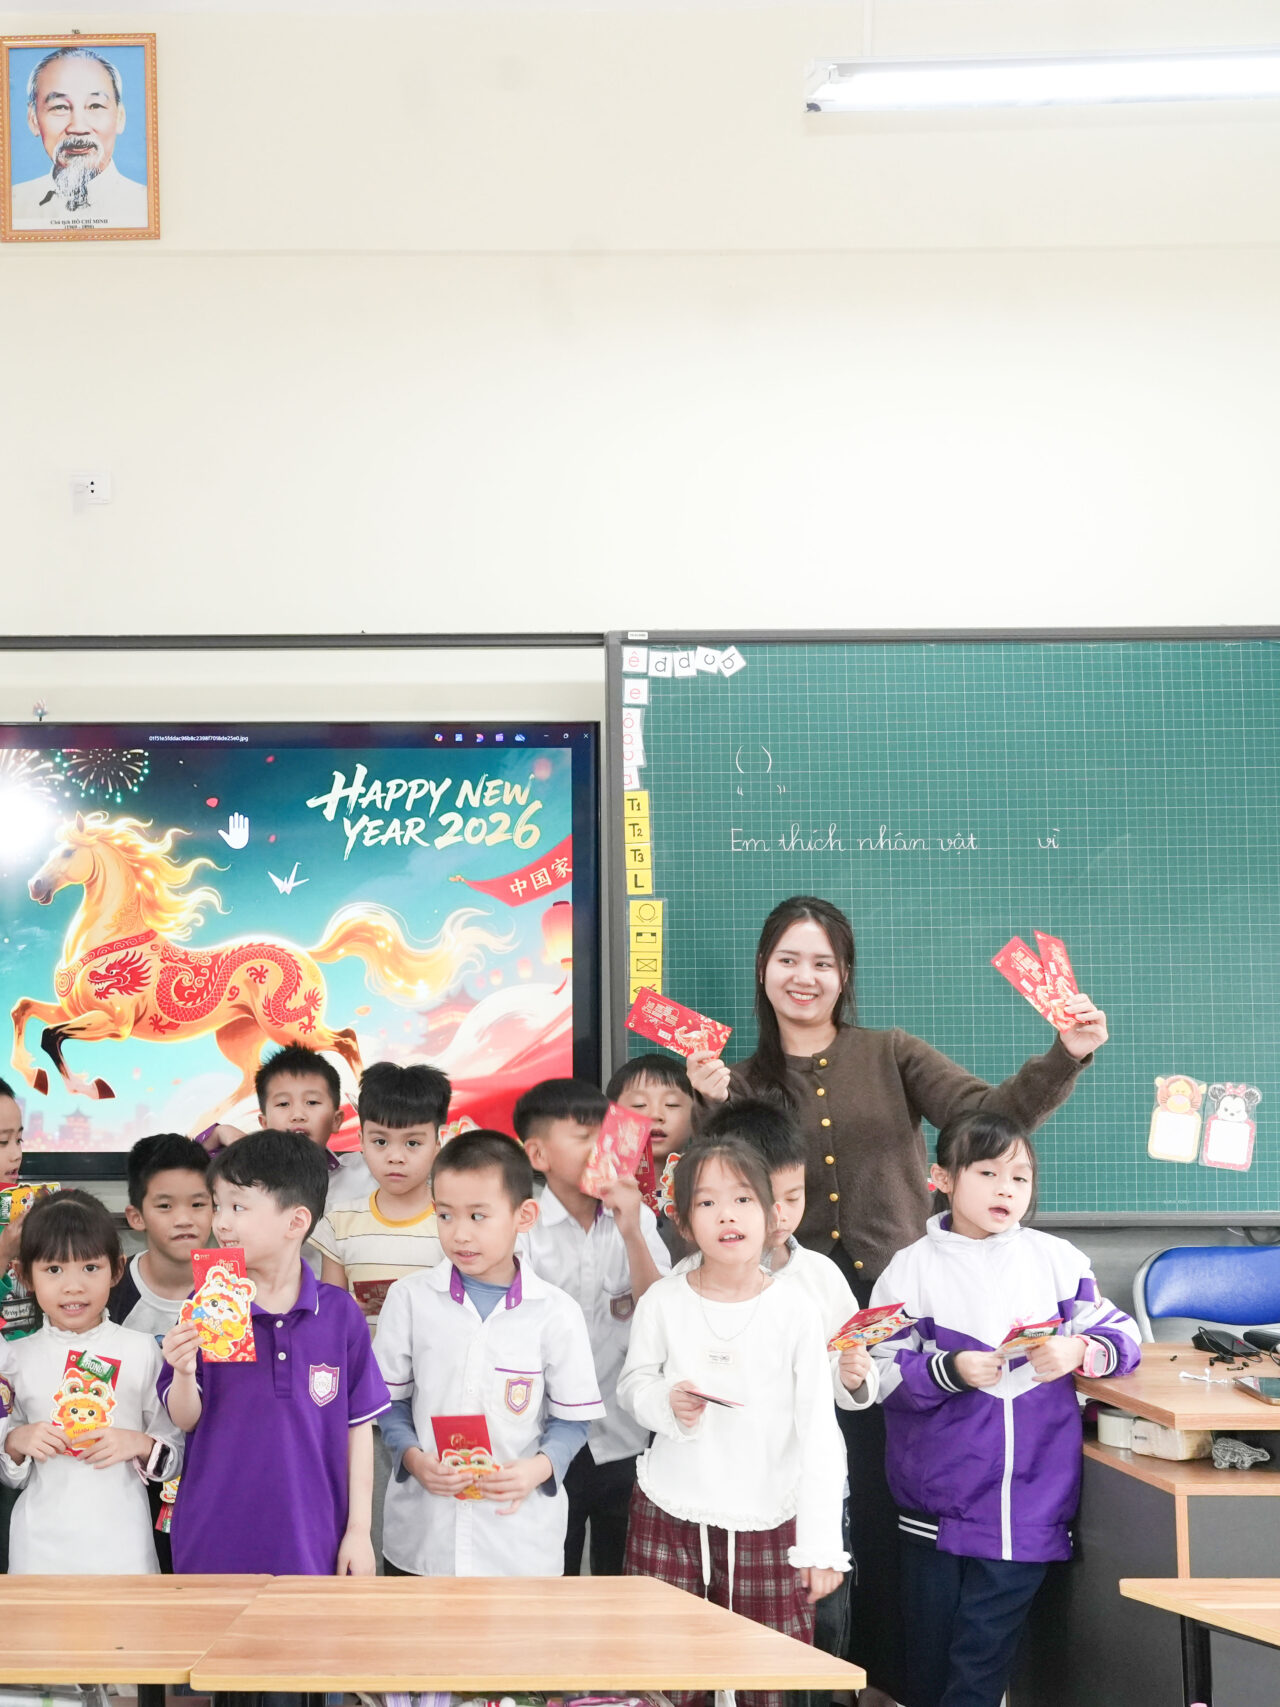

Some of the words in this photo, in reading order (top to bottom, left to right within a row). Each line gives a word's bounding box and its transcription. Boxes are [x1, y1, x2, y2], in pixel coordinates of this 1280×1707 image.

[630, 688, 641, 699] e
[306, 763, 452, 821] HAPPY
[455, 773, 535, 809] NEW
[627, 798, 641, 811] T1
[342, 814, 430, 860] YEAR
[433, 800, 543, 850] 2026
[628, 823, 643, 837] T2
[731, 828, 770, 851] Em
[778, 823, 846, 851] thích
[857, 824, 929, 850] nhân
[937, 832, 978, 855] vật
[1037, 828, 1060, 849] vì
[630, 849, 644, 862] T3
[510, 856, 572, 898] 中国家
[634, 873, 644, 888] L
